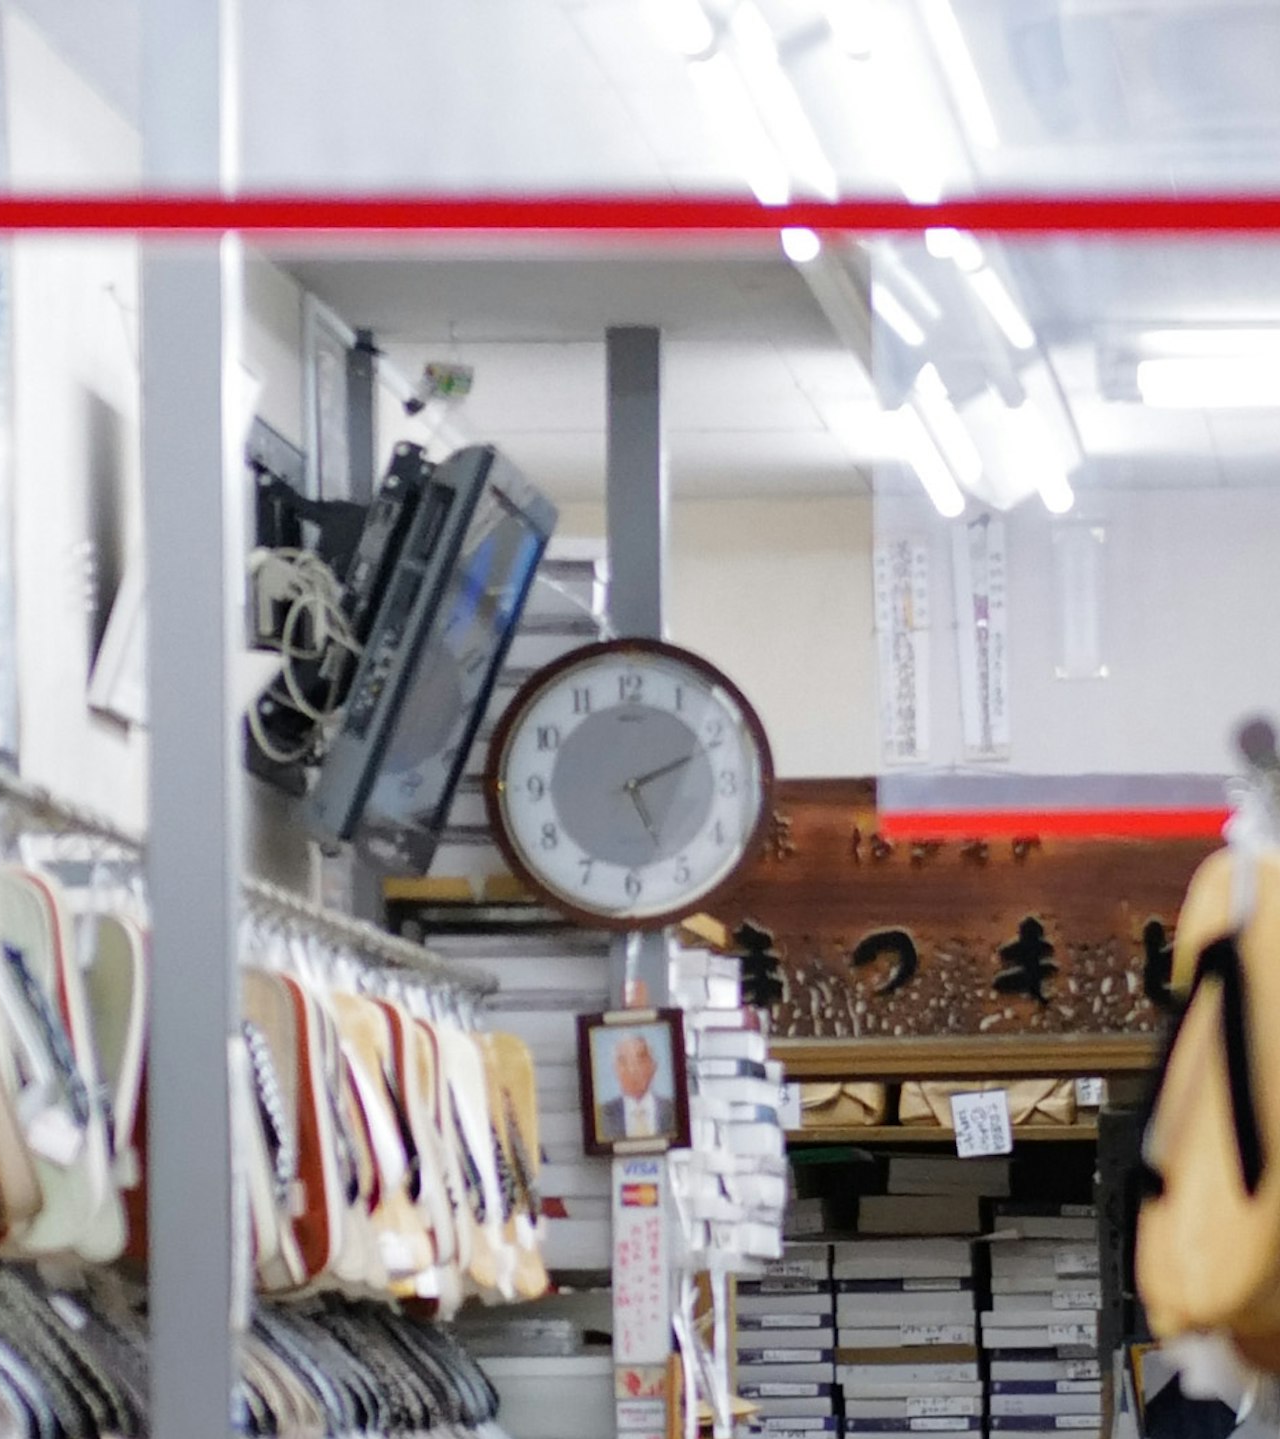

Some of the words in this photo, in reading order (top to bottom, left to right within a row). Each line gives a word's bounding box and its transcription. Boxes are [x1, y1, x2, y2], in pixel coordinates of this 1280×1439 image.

[573, 689, 592, 711] 11
[617, 675, 643, 701] 12
[675, 688, 684, 710] 1
[537, 727, 559, 750] 10
[706, 723, 724, 747] 2
[527, 776, 544, 801] 9
[721, 771, 735, 795] 3
[541, 823, 558, 848] 8
[579, 860, 593, 885] 7
[674, 860, 690, 883] 5
[625, 872, 642, 899] 6
